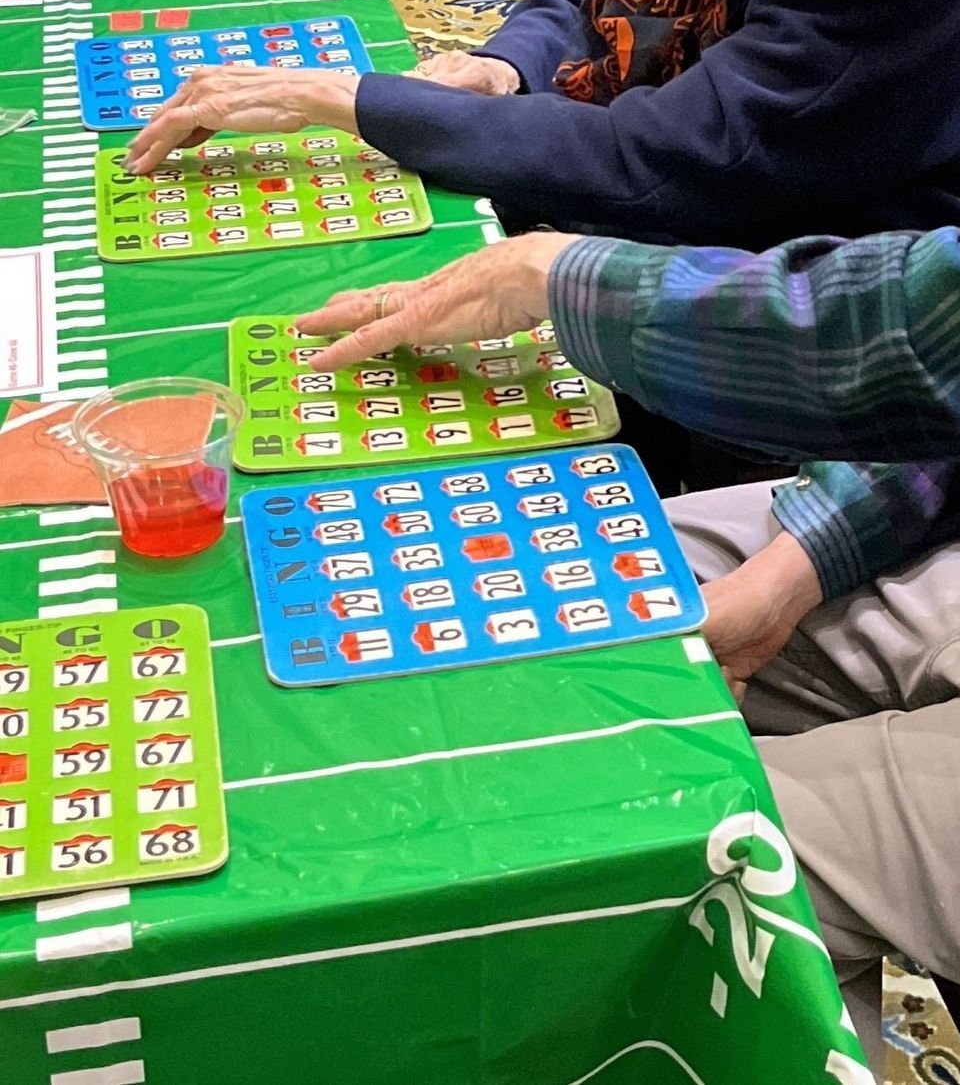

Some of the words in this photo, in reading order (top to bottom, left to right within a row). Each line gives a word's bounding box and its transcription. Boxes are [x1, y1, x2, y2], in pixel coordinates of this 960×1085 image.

[158, 189, 184, 203] 36
[211, 184, 239, 198] 32
[376, 188, 404, 203] 28
[269, 202, 297, 215] 27
[323, 194, 351, 209] 24
[159, 210, 187, 225] 30
[214, 204, 242, 220] 26
[382, 210, 410, 225] 13
[329, 217, 356, 231] 14
[161, 234, 189, 247] 12
[217, 229, 245, 242] 15
[247, 323, 277, 340] O
[248, 349, 277, 366] G
[249, 375, 279, 393] N
[301, 375, 333, 392] 38
[363, 370, 395, 387] 43
[494, 387, 525, 403] 16
[553, 379, 587, 399] 22
[303, 405, 336, 420] 21
[367, 400, 400, 418] 27
[429, 396, 462, 410] 17
[251, 407, 281, 420] I
[371, 431, 403, 448] 13
[435, 428, 467, 439] 9
[252, 434, 284, 457] B
[306, 439, 338, 449] 4
[518, 466, 552, 485] 64
[579, 457, 616, 476] 63
[384, 484, 420, 504] 72
[450, 476, 486, 494] 68
[318, 492, 352, 511] 70
[528, 495, 564, 514] 46
[593, 485, 631, 506] 56
[263, 496, 296, 515] O
[460, 504, 498, 524] 60
[323, 521, 360, 541] 48
[397, 514, 430, 533] 50
[606, 518, 645, 539] 45
[268, 527, 302, 548] G
[540, 527, 579, 551] 38
[402, 547, 441, 570] 35
[274, 561, 311, 584] N
[331, 557, 370, 580] 37
[554, 564, 593, 586] 16
[483, 573, 523, 598] 20
[340, 593, 380, 617] 29
[412, 585, 452, 606] 18
[283, 600, 317, 619] I
[569, 604, 609, 627] 13
[55, 625, 102, 647] G
[133, 619, 180, 639] O
[432, 627, 463, 641] 6
[497, 619, 535, 634] 3
[290, 636, 328, 667] B
[358, 637, 389, 653] 11
[3, 670, 26, 693] 9
[59, 661, 103, 687] 57
[137, 653, 182, 677] 62
[2, 713, 24, 737] 0
[60, 705, 105, 731] 55
[141, 696, 186, 722] 72
[60, 748, 106, 776] 59
[141, 740, 187, 765] 67
[65, 795, 100, 821] 51
[151, 785, 185, 811] 71
[58, 840, 108, 869] 56
[145, 829, 195, 857] 68
